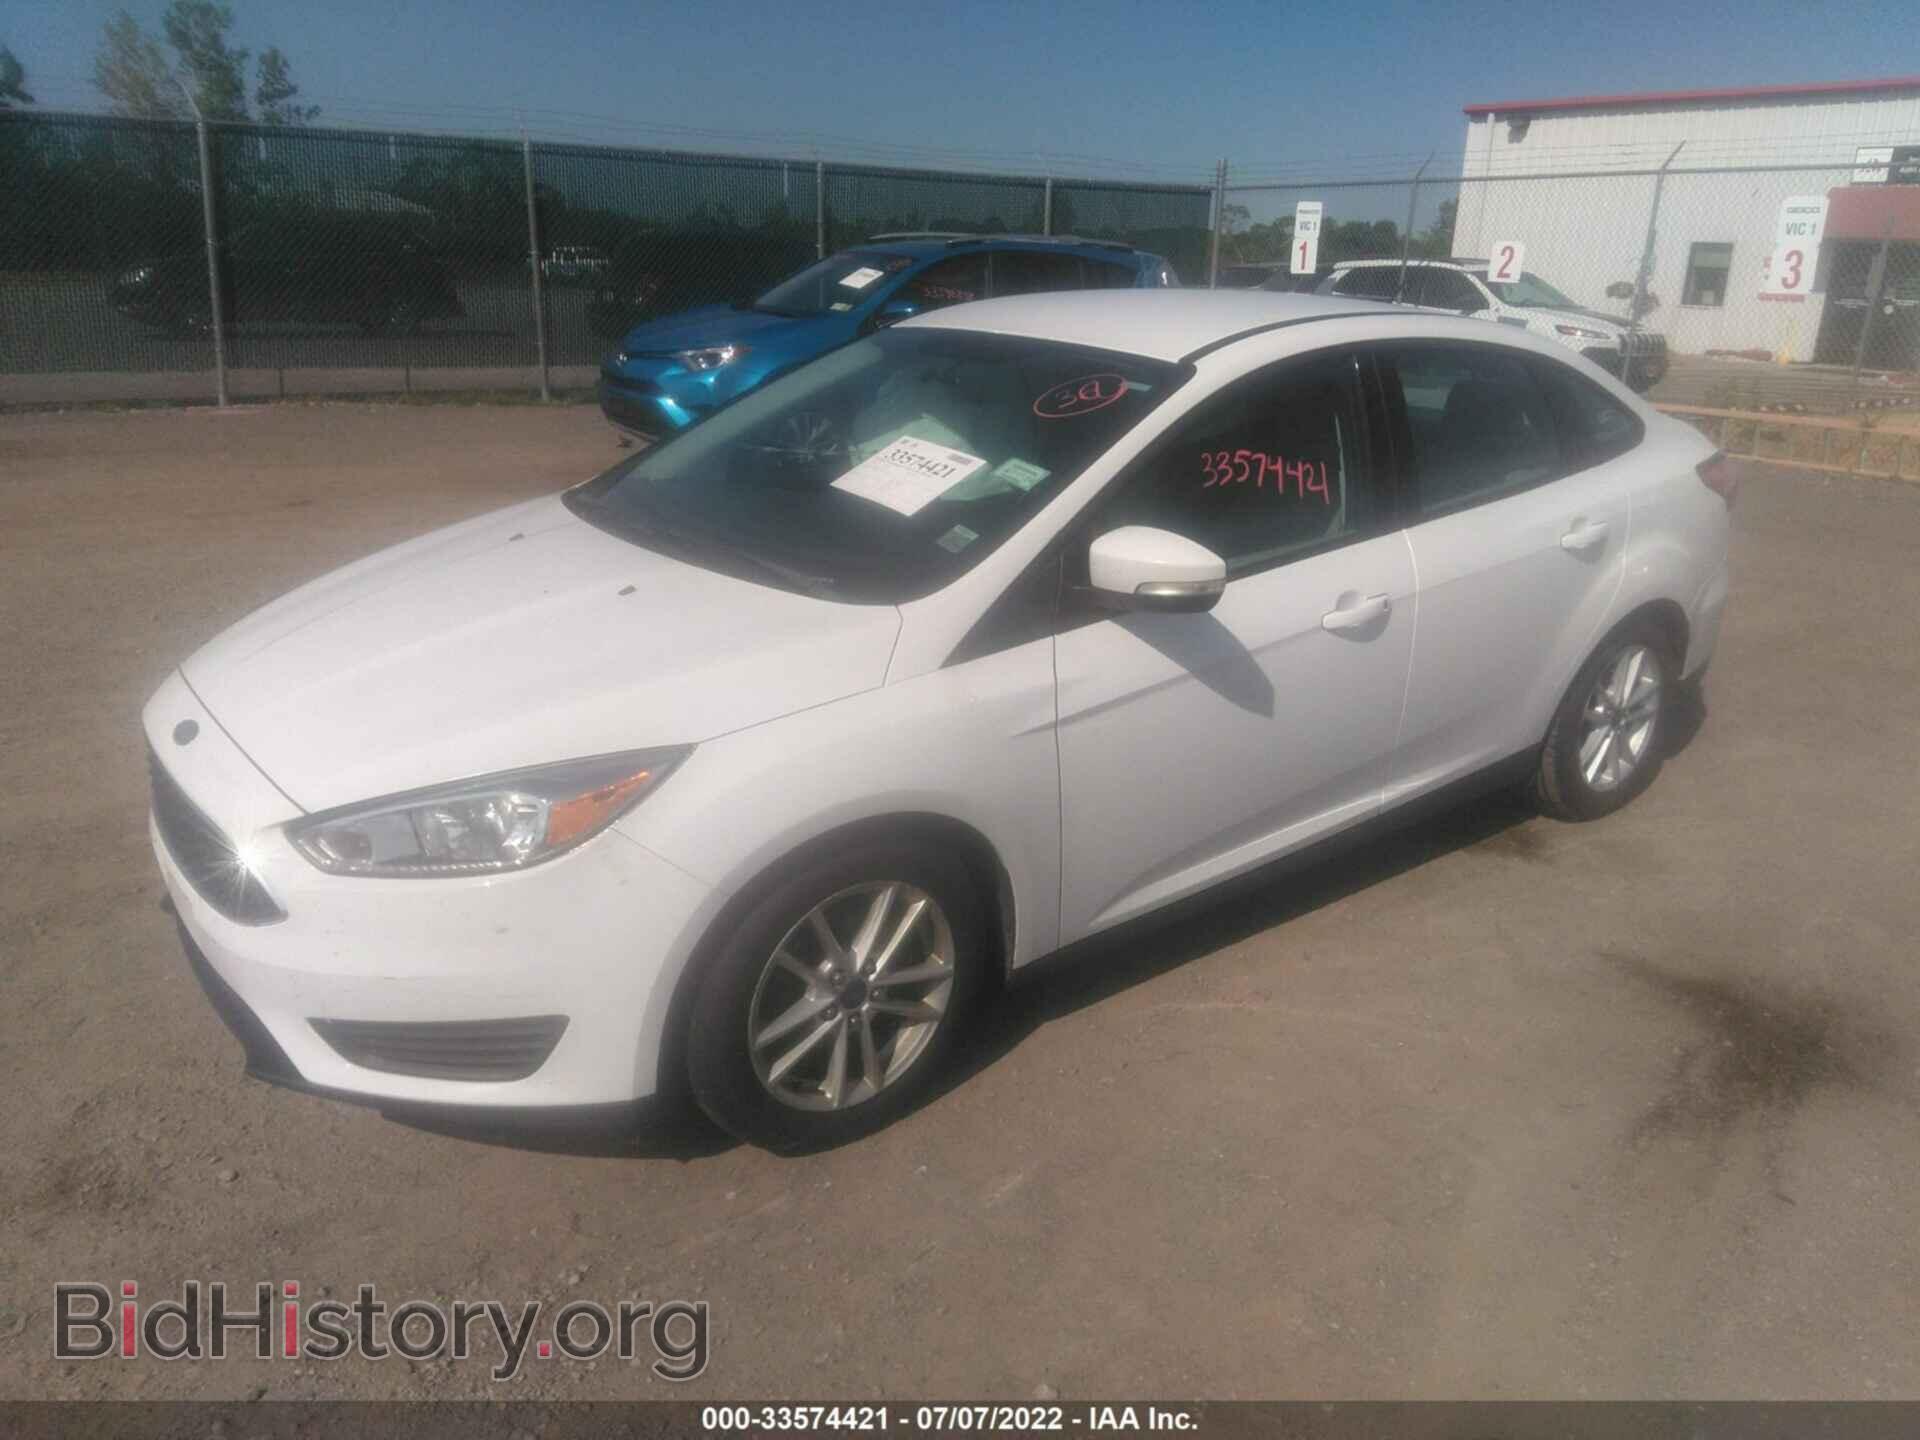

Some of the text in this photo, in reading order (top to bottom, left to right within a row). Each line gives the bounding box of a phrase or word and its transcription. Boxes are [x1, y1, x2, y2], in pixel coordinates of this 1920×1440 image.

[1786, 222, 1807, 236] VIC
[1299, 241, 1307, 270] 1
[1497, 245, 1515, 279] 2
[1781, 249, 1804, 289] 3
[1201, 449, 1330, 504] 33574421
